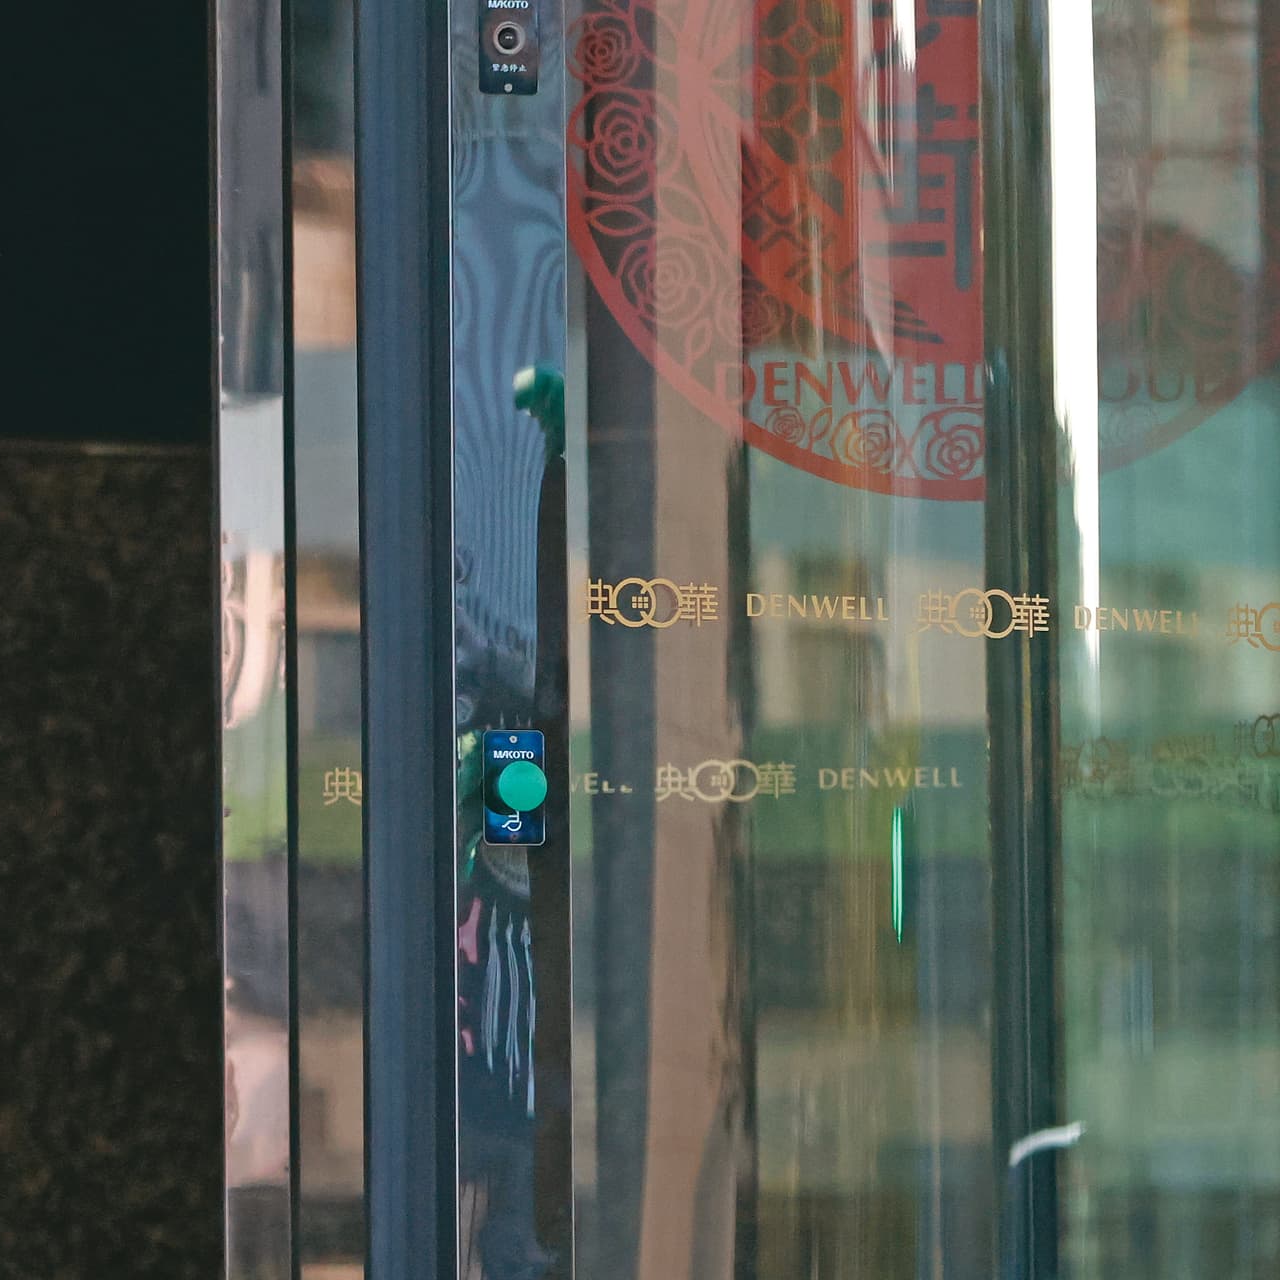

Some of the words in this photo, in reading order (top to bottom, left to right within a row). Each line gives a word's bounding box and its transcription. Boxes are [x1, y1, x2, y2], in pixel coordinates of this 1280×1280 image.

[716, 360, 985, 405] DENWELL
[746, 593, 889, 621] DENWELL
[1073, 604, 1198, 635] DENWELL
[818, 766, 965, 791] DENWELL
